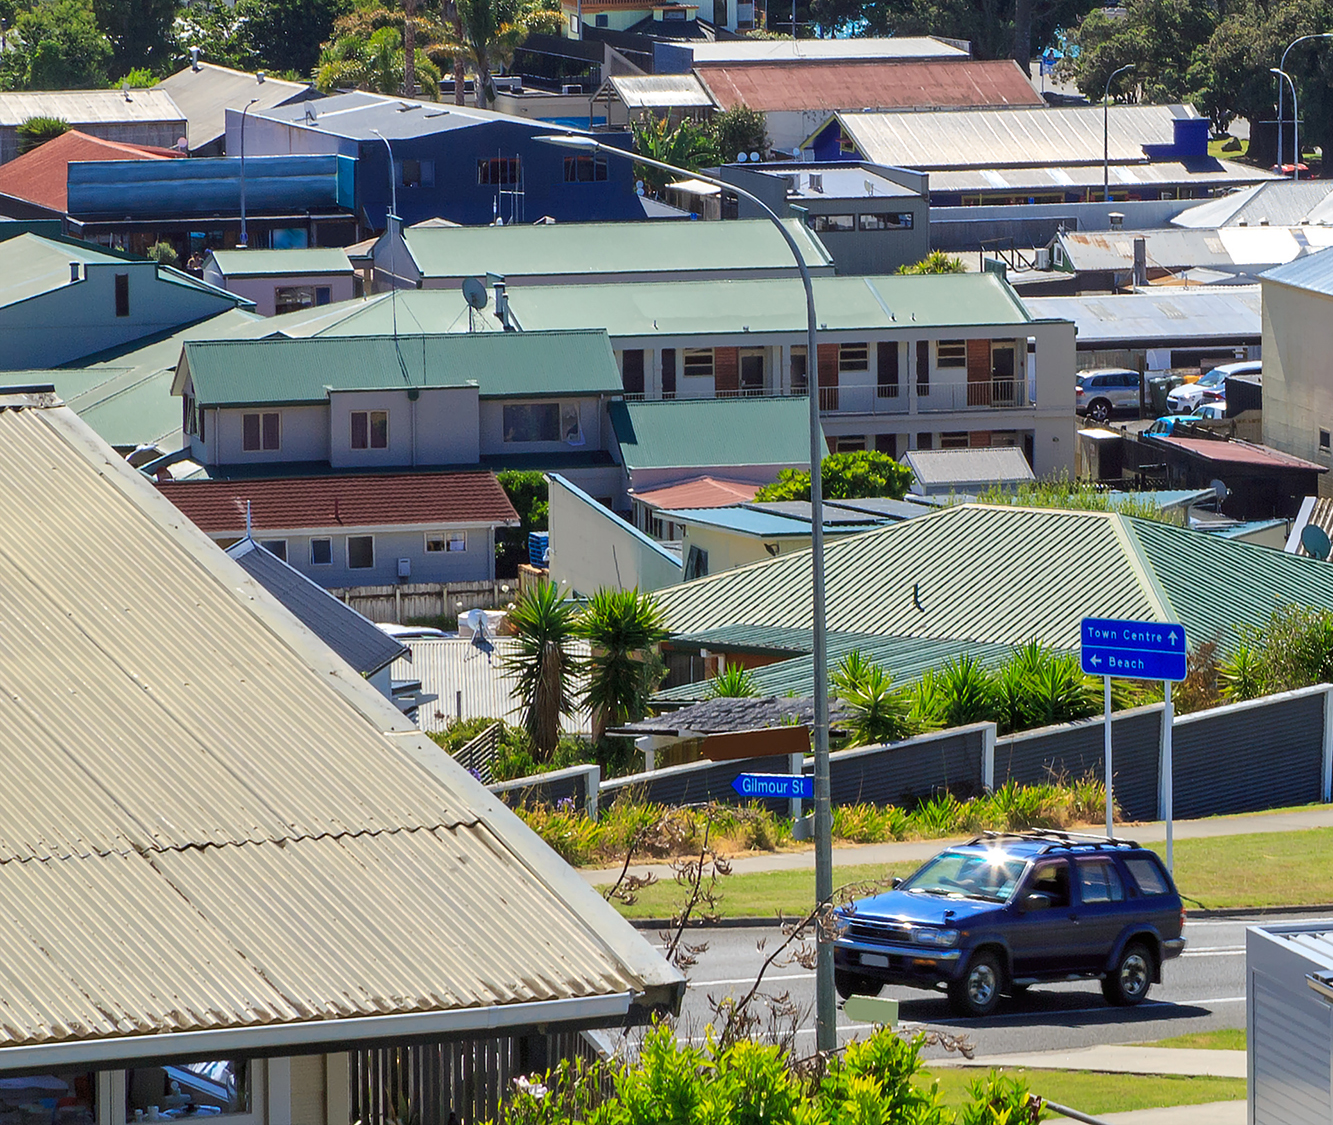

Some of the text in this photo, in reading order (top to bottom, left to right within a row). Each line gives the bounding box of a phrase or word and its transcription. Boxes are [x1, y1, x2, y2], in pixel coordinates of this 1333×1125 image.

[1087, 626, 1162, 642] Town Centre
[1108, 656, 1144, 669] Beach
[742, 777, 804, 794] Gilmour St
